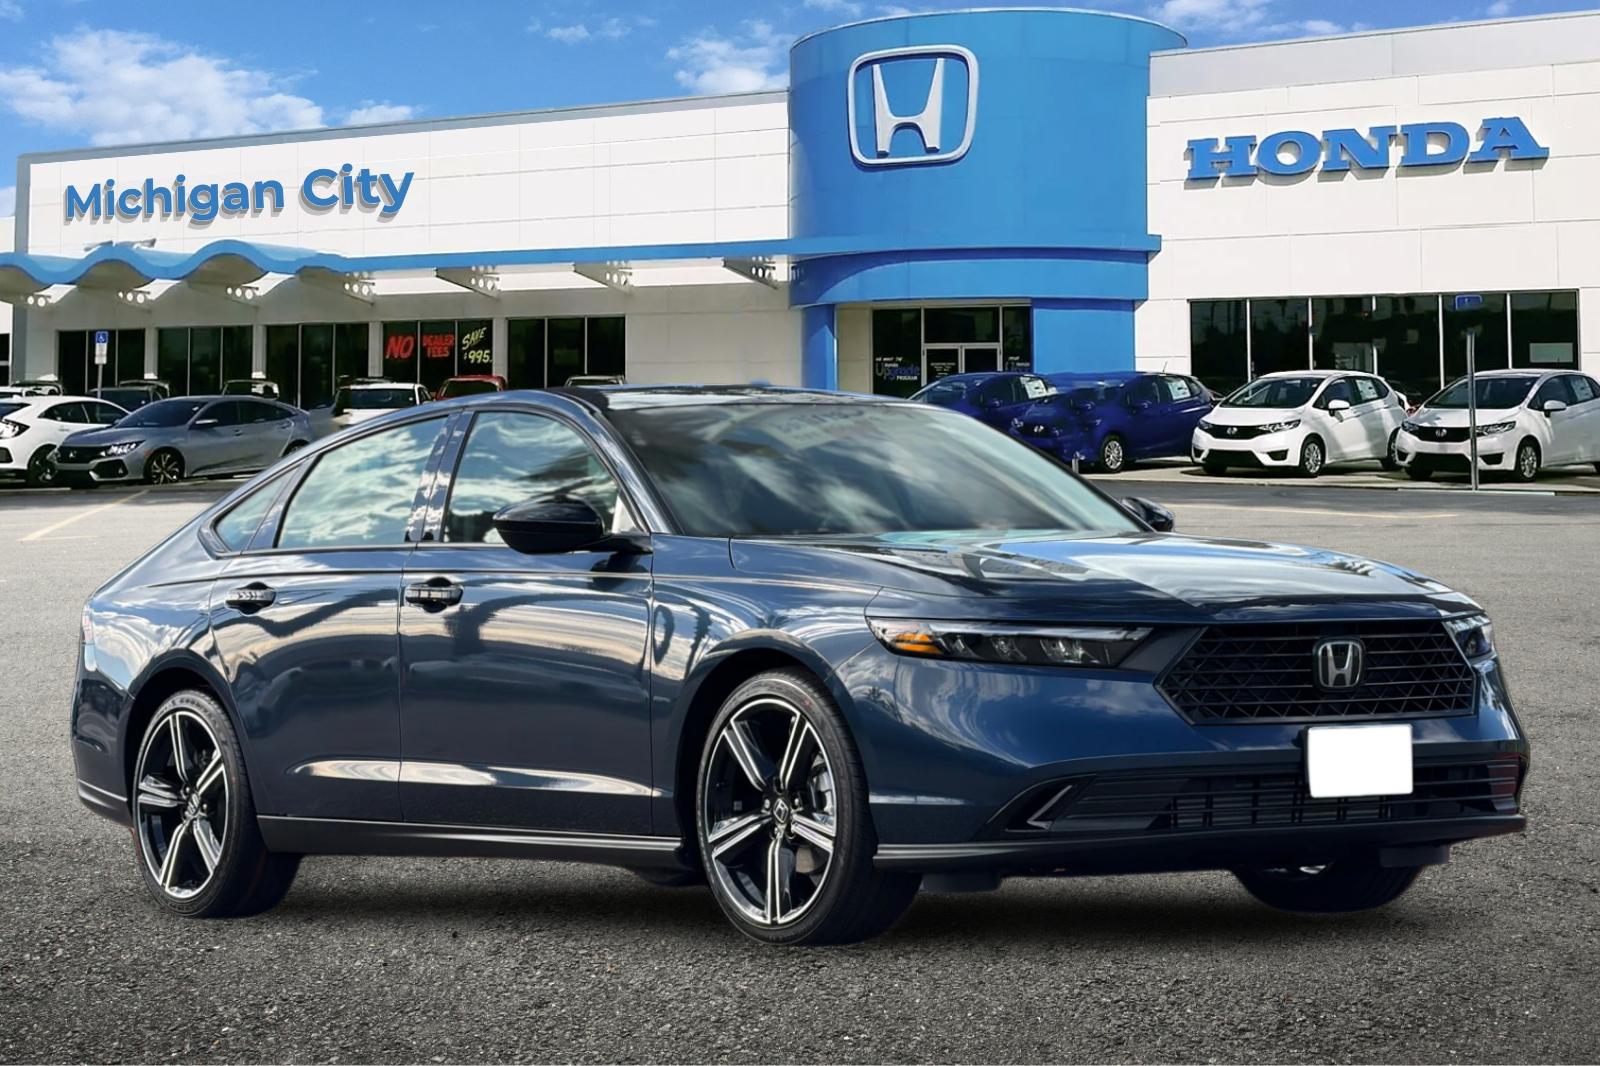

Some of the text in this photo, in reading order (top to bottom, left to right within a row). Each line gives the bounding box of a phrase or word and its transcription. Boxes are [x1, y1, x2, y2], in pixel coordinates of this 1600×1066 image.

[1187, 116, 1549, 181] HONDA
[65, 163, 414, 221] Michigan City
[385, 335, 414, 359] NO
[462, 327, 487, 350] SAVE
[427, 346, 450, 358] FEES
